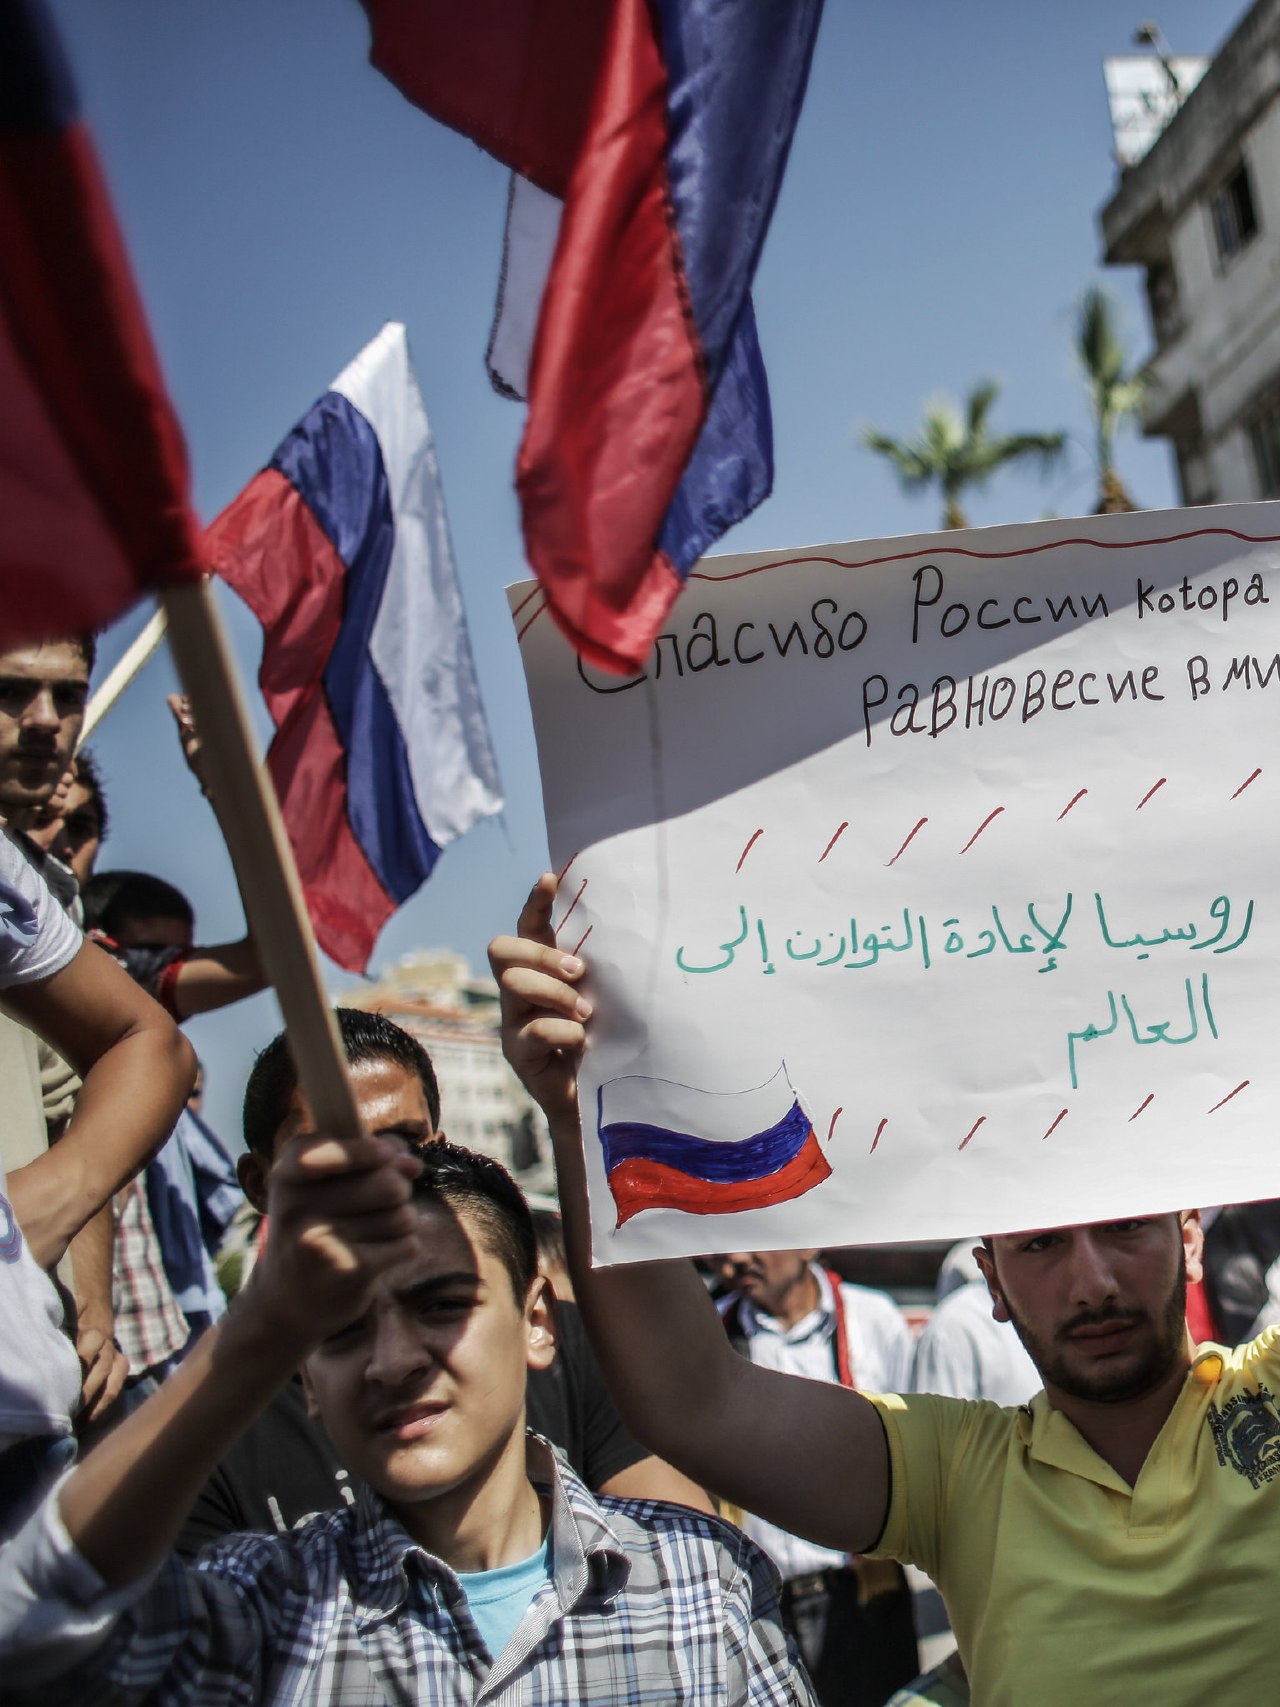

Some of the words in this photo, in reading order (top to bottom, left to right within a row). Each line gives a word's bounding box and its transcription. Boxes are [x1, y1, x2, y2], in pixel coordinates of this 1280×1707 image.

[911, 564, 1109, 644] России
[676, 903, 776, 975] إلى
[785, 906, 931, 969] التوازن
[942, 891, 1073, 974] لإعادة
[1094, 891, 1255, 960] روسيا
[1067, 971, 1219, 1090] العالم
